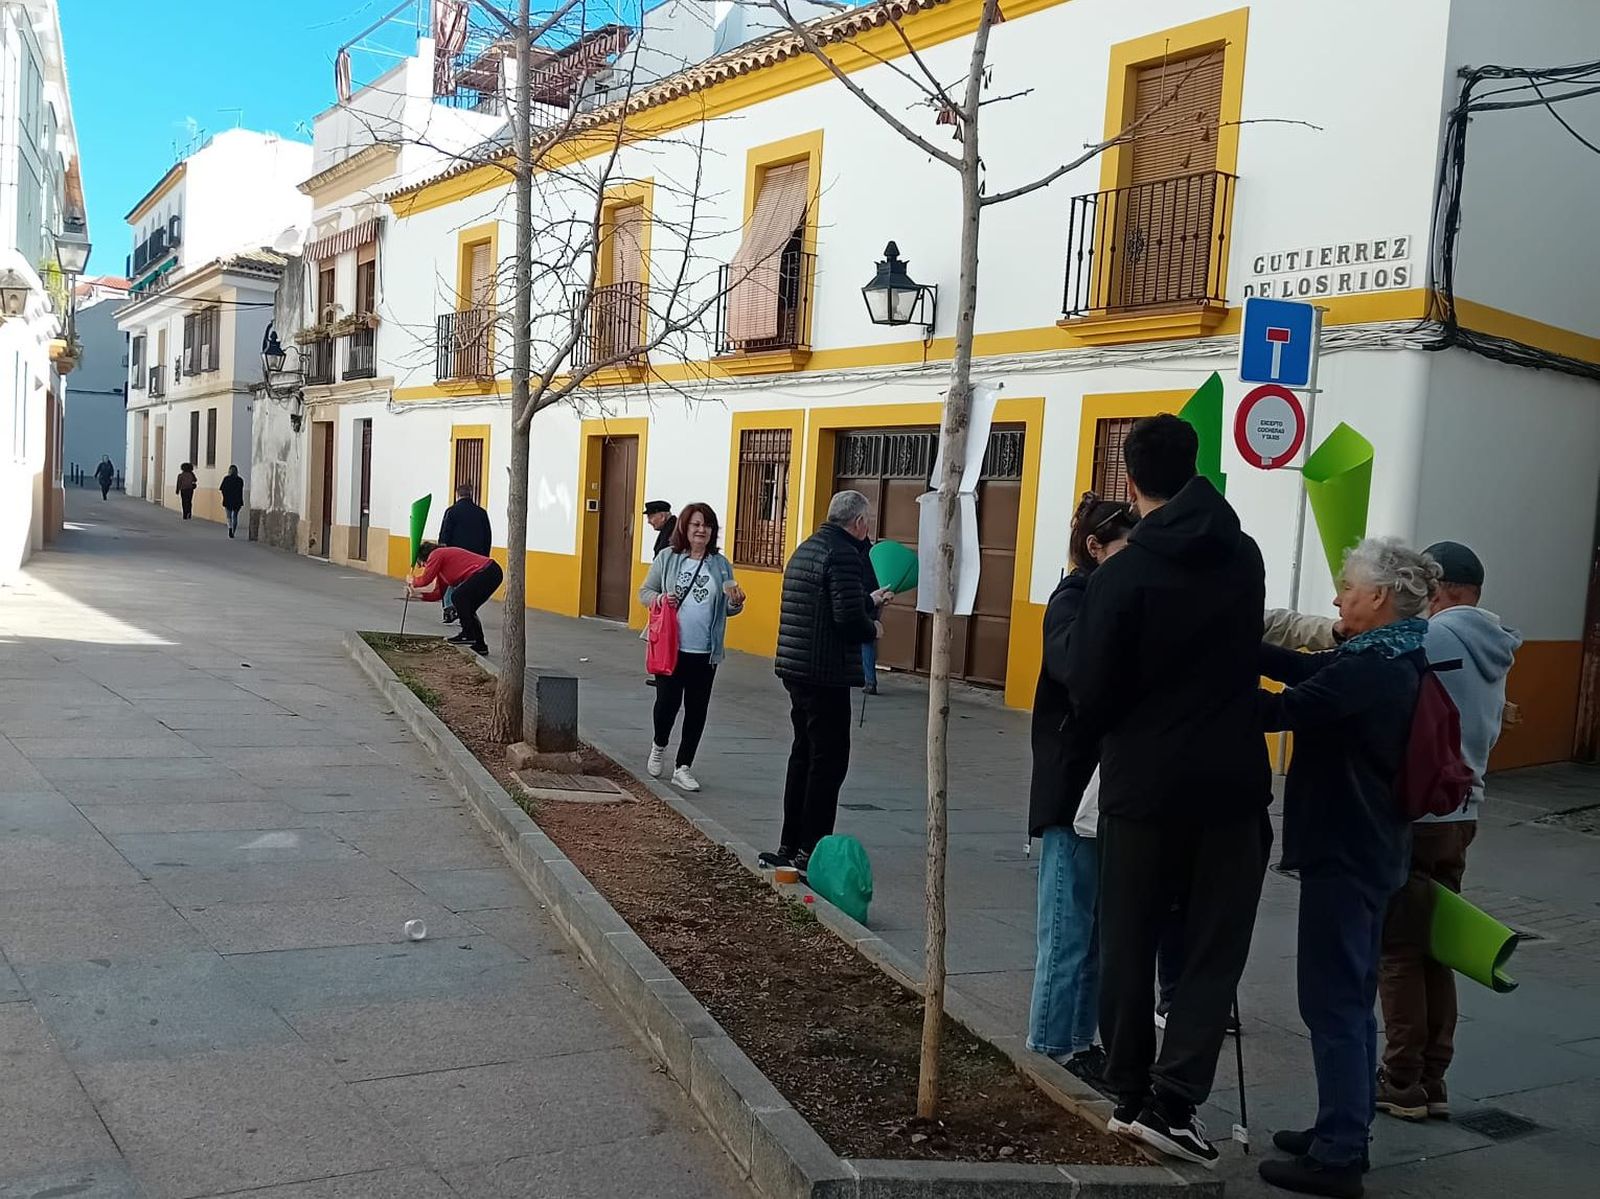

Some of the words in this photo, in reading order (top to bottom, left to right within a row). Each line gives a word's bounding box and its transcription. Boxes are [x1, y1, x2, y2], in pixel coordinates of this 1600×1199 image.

[1253, 237, 1407, 274] GUTIERREZ
[1244, 282, 1271, 298] DE
[1282, 275, 1329, 298] LOS
[1338, 266, 1407, 292] RIOS
